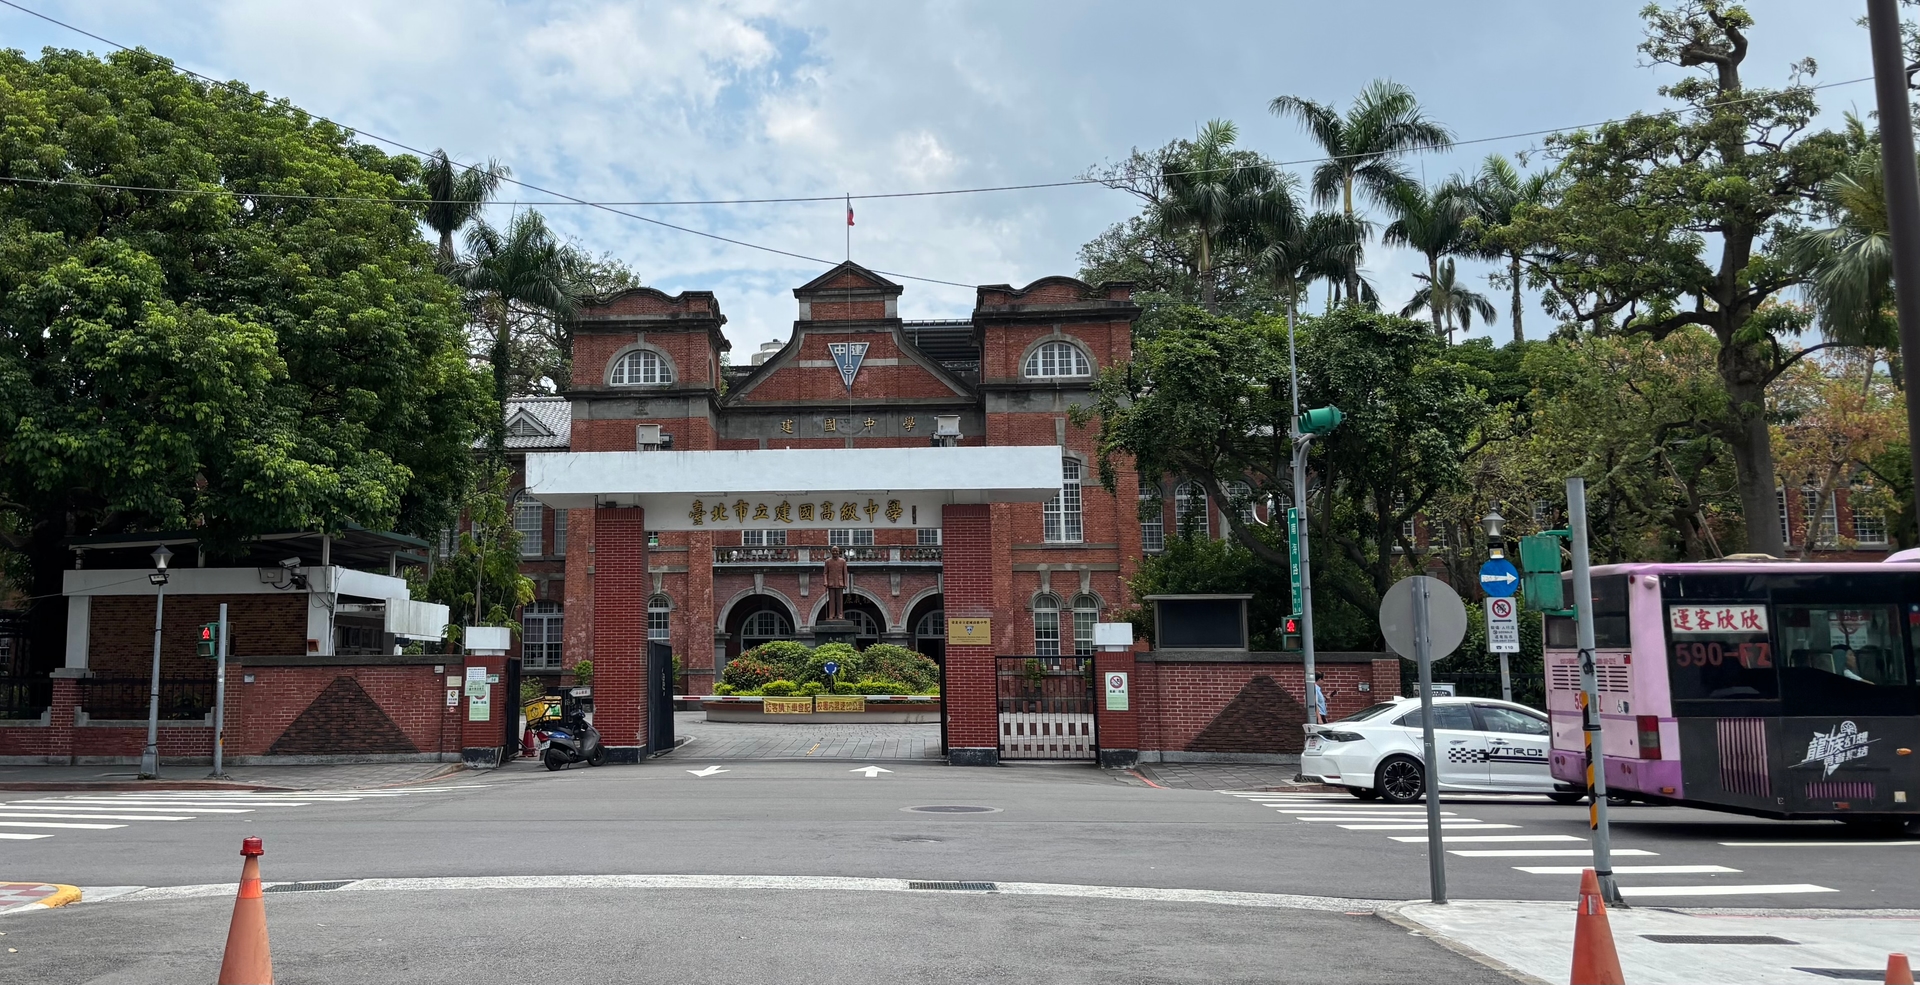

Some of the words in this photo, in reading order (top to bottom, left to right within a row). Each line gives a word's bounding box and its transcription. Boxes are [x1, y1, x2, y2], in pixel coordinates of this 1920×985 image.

[780, 416, 916, 434] 建國中學
[688, 498, 903, 526] 臺北市立建國高級中學
